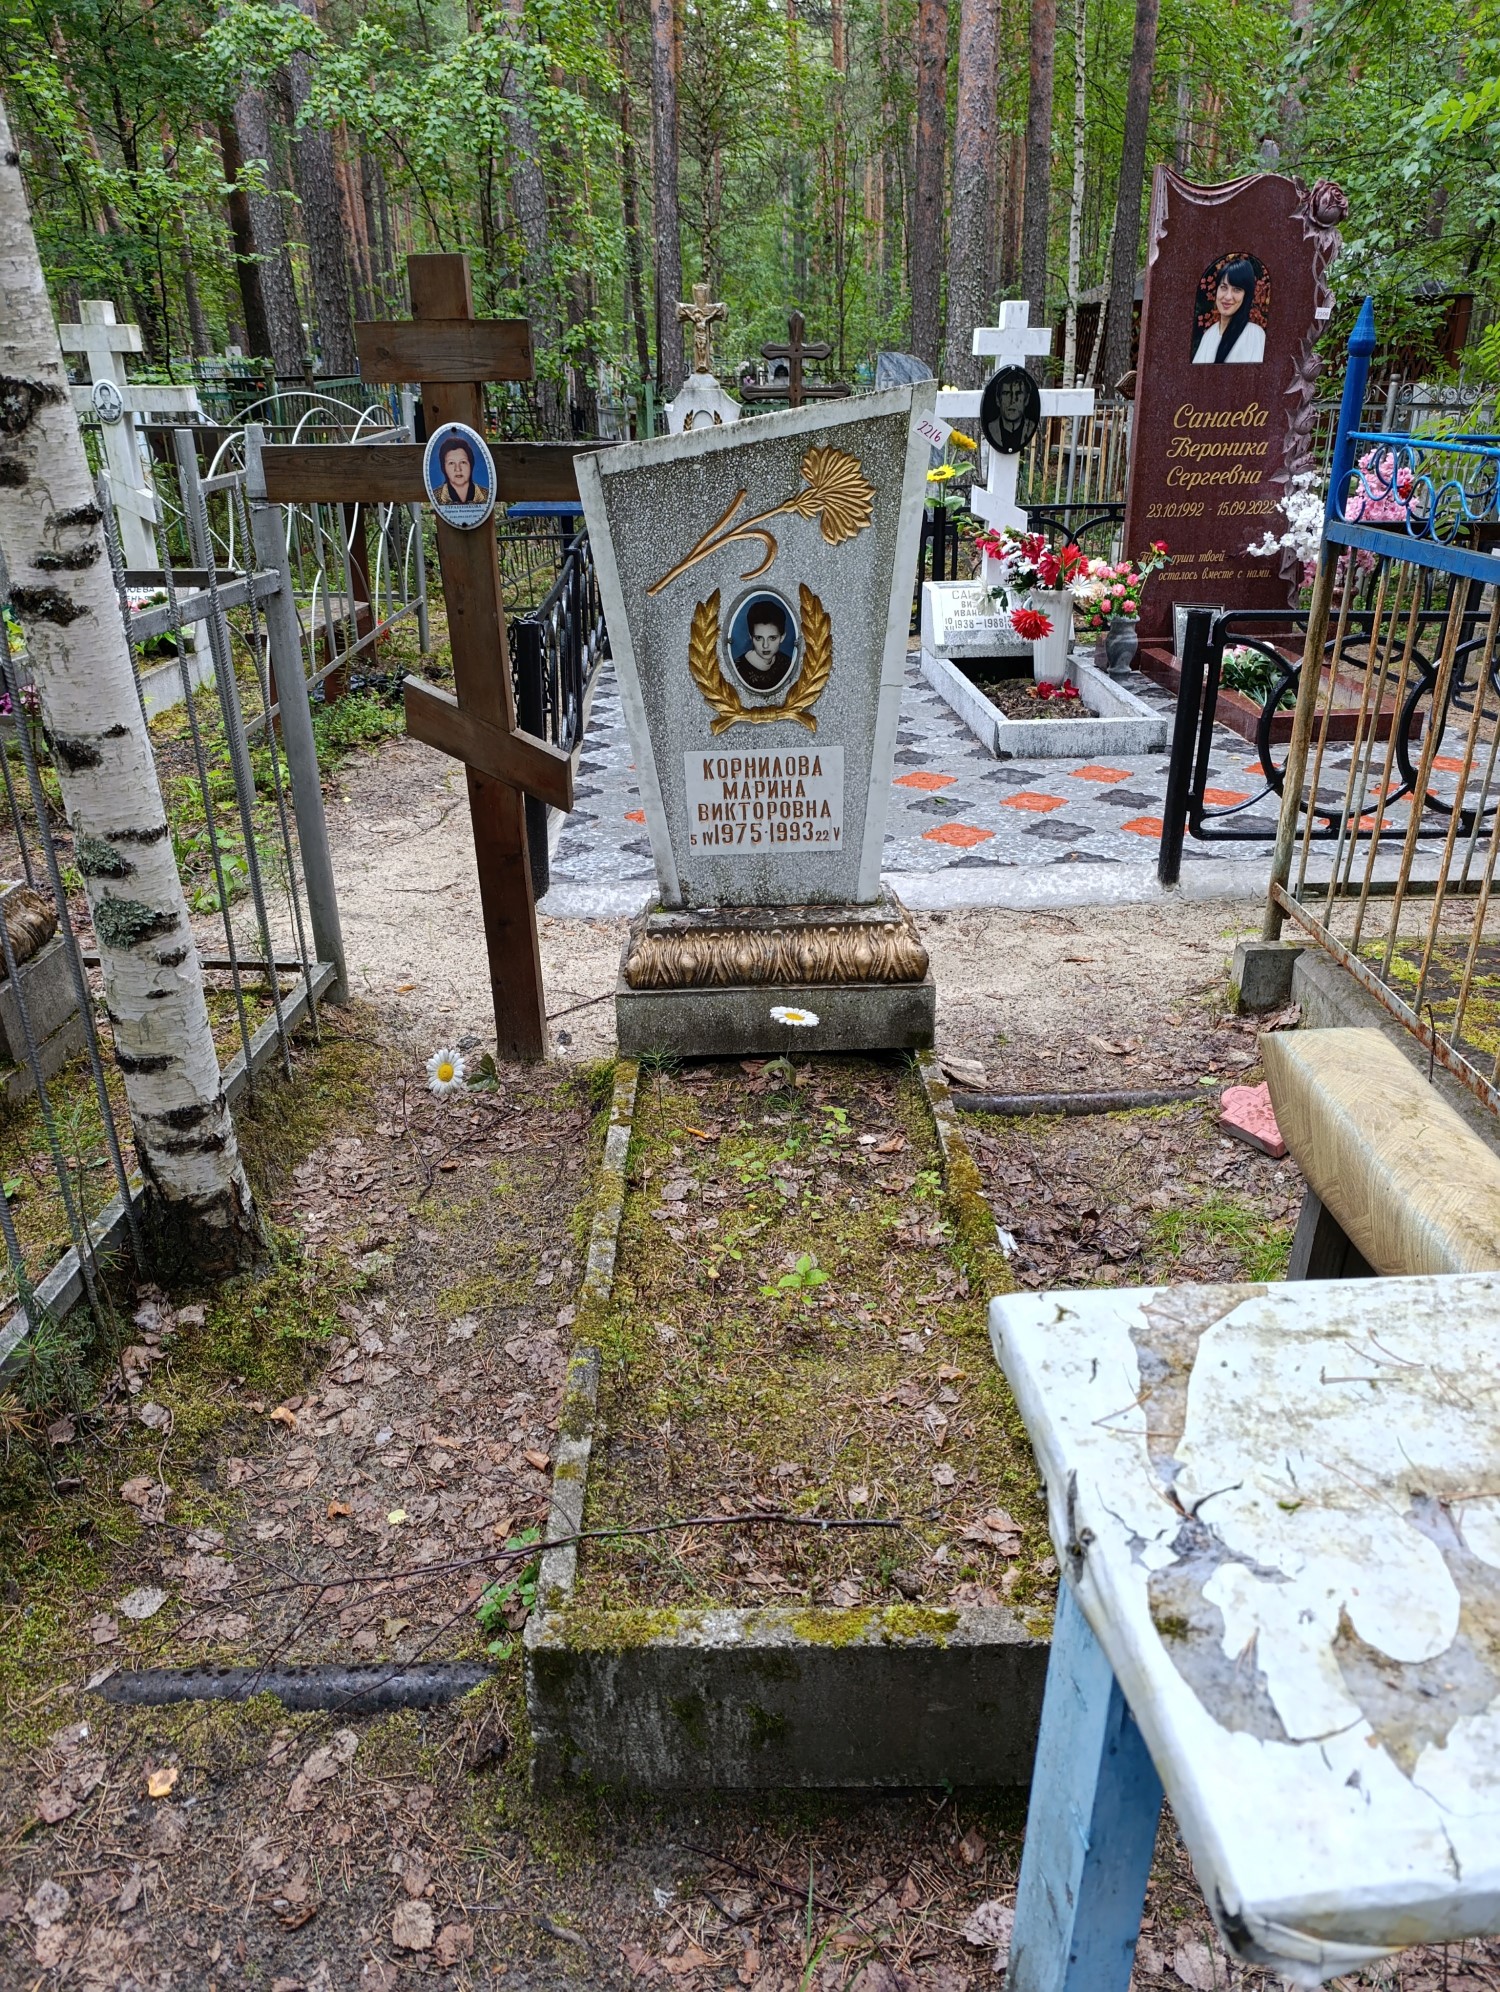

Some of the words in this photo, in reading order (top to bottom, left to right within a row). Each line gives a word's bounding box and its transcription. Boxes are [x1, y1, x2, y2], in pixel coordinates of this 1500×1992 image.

[1173, 402, 1269, 428] Санаева
[917, 420, 943, 443] 2216
[1166, 436, 1269, 462] Вероника
[1166, 463, 1263, 491] Сергеевна
[1146, 502, 1205, 518] 23.10.1992
[1216, 500, 1277, 516] 15.09.2022
[1170, 553, 1195, 566] души
[1158, 569, 1198, 581] осталось
[1201, 567, 1235, 580] вместе
[1237, 571, 1243, 579] с
[1246, 569, 1272, 578] нами.
[702, 755, 823, 781] КОРНИЛОВА
[722, 779, 806, 800] МАРИНА
[698, 800, 832, 822] ВИКТОРОВНА
[690, 834, 698, 846] 5
[815, 829, 829, 842] 22
[833, 826, 840, 842] V
